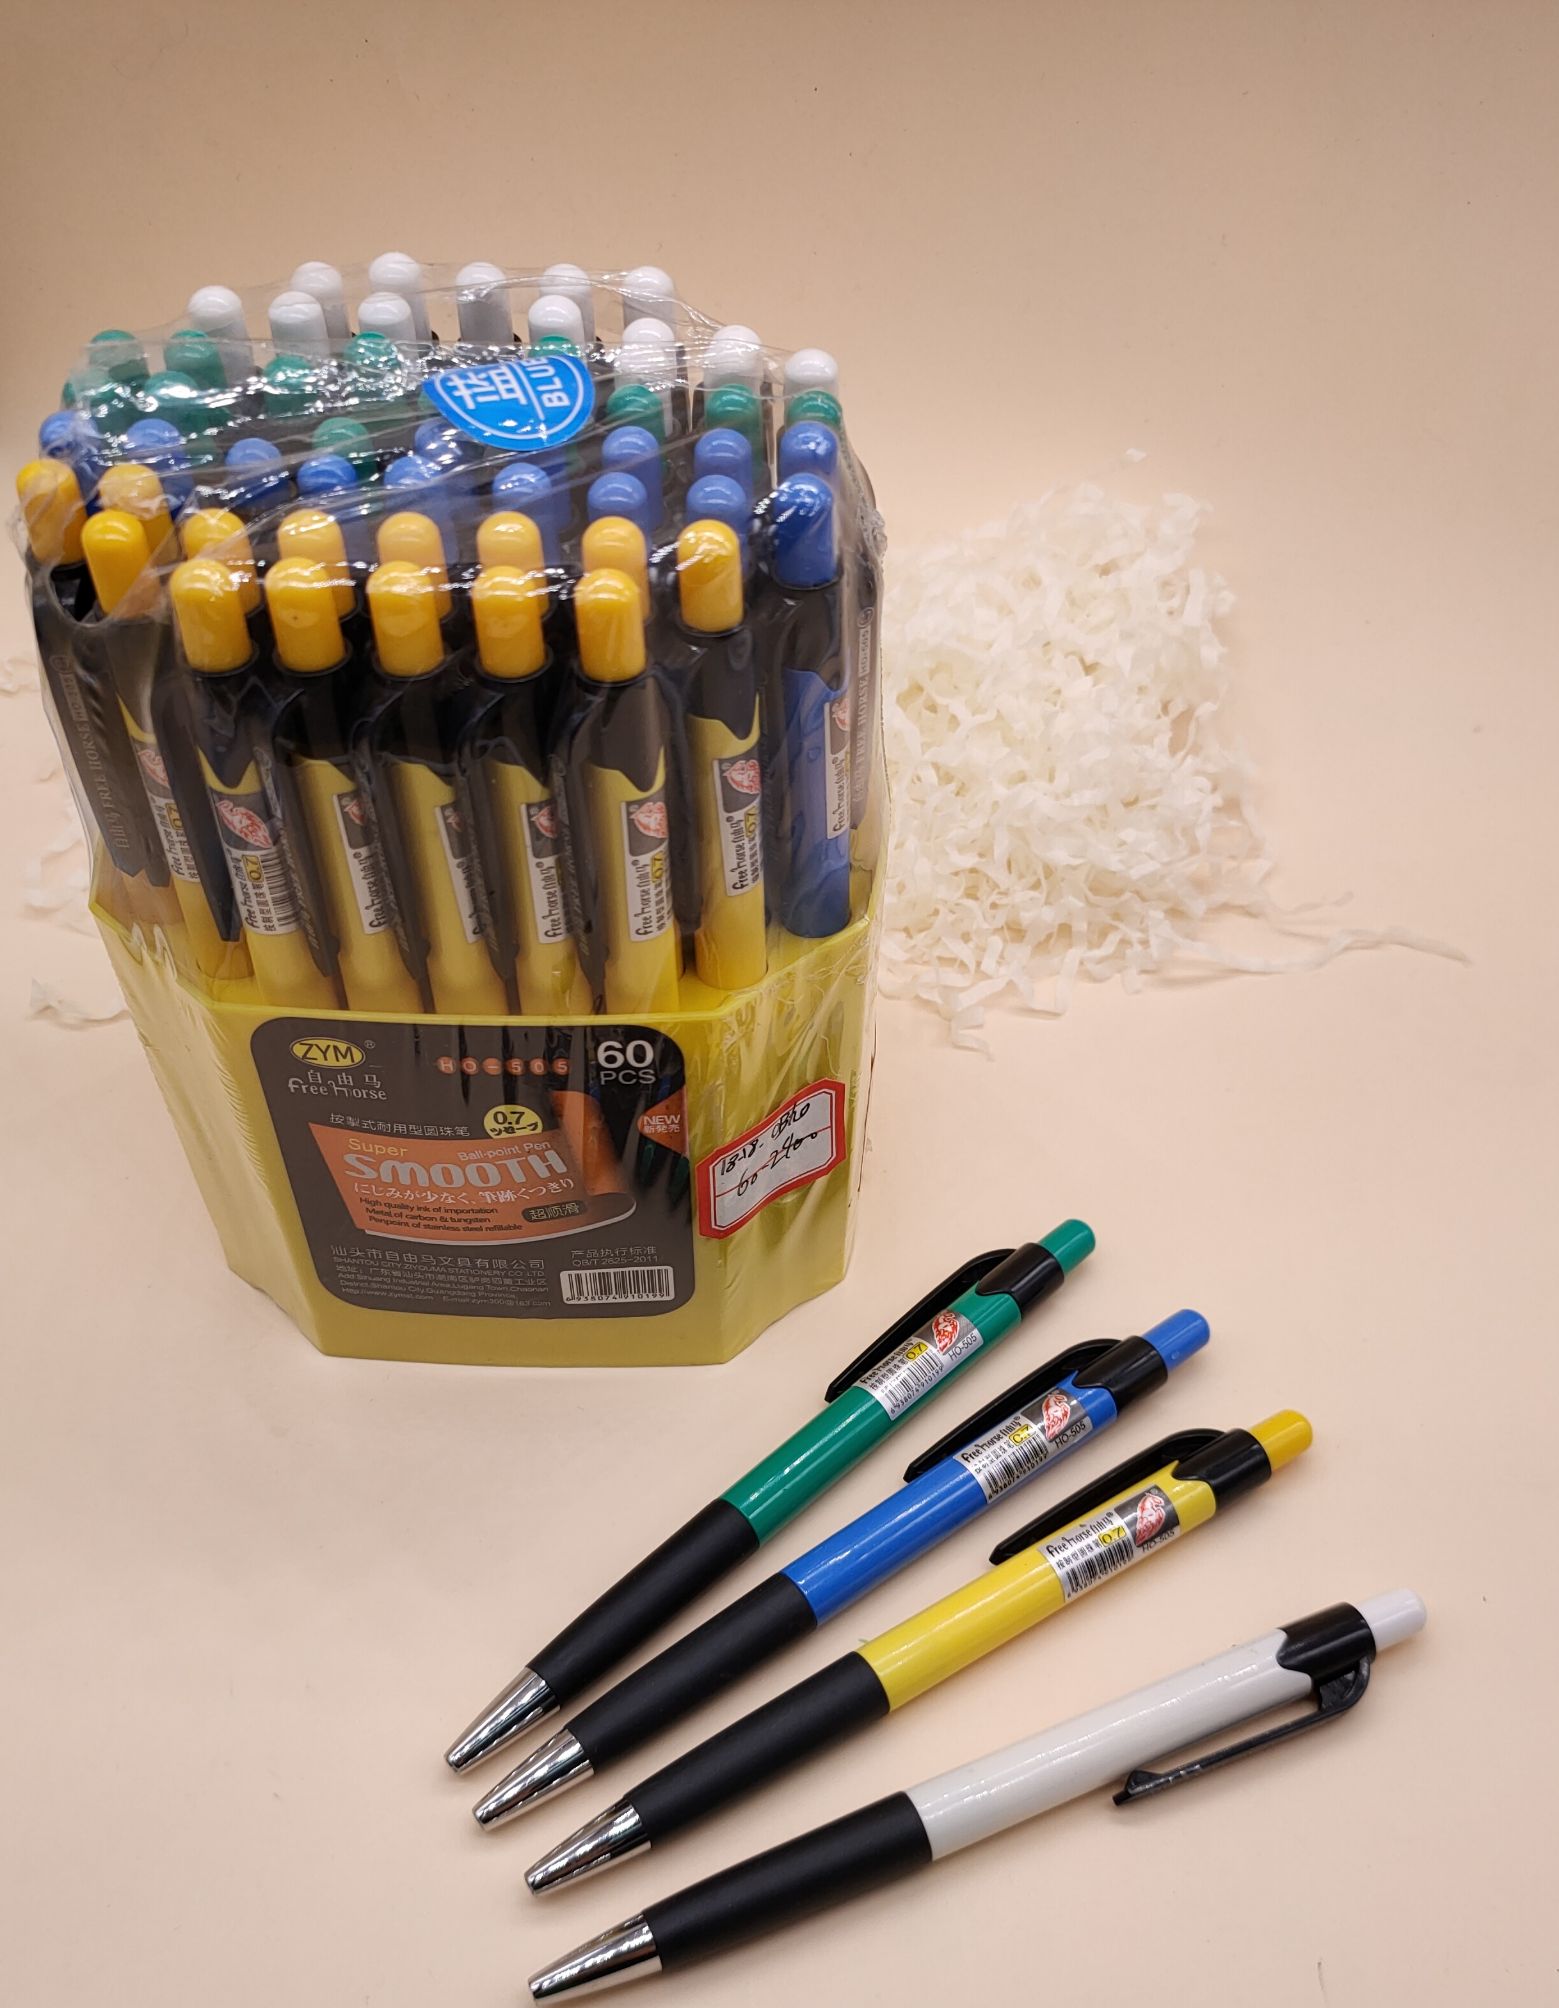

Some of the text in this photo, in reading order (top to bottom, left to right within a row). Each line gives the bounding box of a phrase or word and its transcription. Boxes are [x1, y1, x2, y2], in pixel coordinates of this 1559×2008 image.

[522, 358, 571, 408] BLUE
[299, 1042, 357, 1063] ZYM
[597, 1039, 654, 1069] 60
[438, 1058, 569, 1075] HO-505
[600, 1069, 656, 1085] PCS
[492, 1110, 526, 1125] 0.7
[643, 1114, 681, 1125] NEW
[348, 1138, 408, 1157] Super
[457, 1141, 550, 1162] Ball-point Pen
[343, 1150, 568, 1189] SMOOTH
[359, 1196, 382, 1209] High
[416, 1204, 431, 1213] ink
[432, 1205, 443, 1214] of
[908, 1343, 924, 1360] 0.7
[948, 1334, 978, 1360] HO-505
[1054, 1421, 1086, 1447] HO-505
